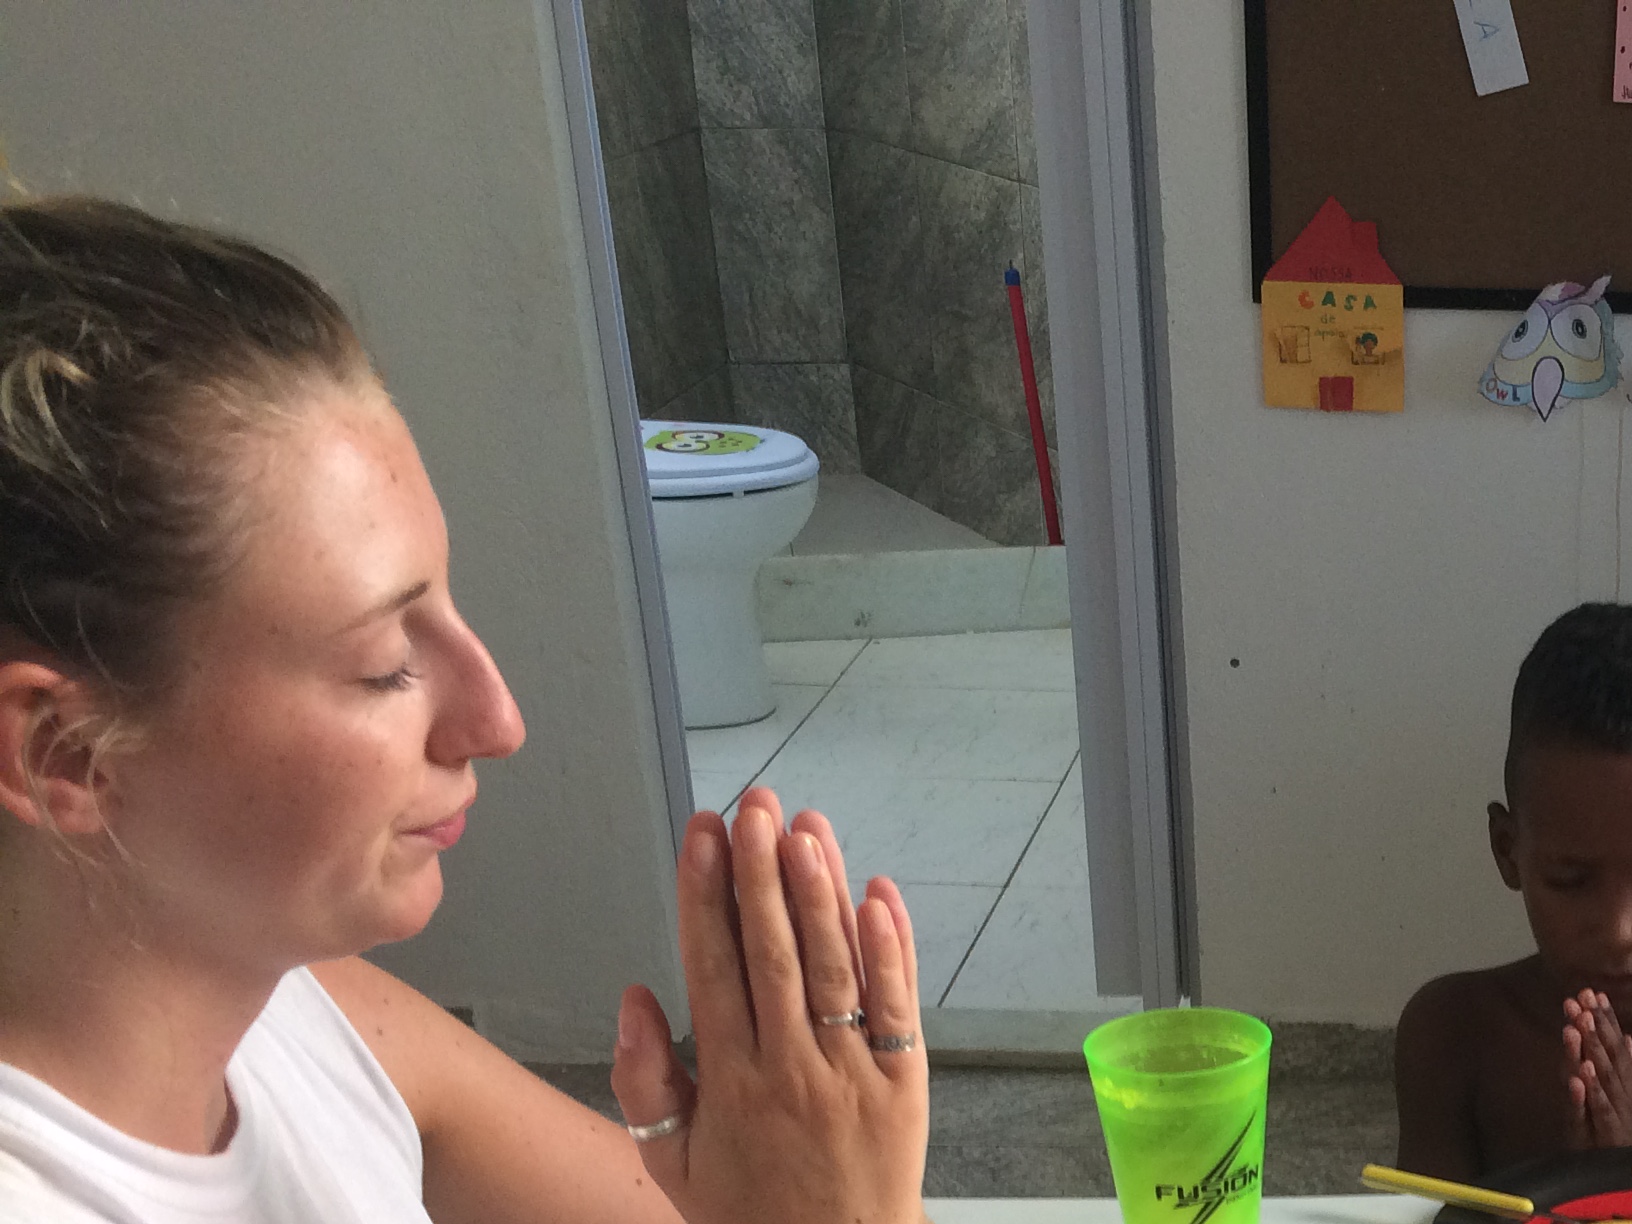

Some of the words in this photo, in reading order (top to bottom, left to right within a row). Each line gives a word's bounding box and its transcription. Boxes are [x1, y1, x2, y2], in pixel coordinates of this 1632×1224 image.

[1297, 289, 1377, 312] CASA
[1320, 313, 1336, 324] de
[1485, 377, 1521, 402] OWL
[1155, 1163, 1259, 1203] FUSION
